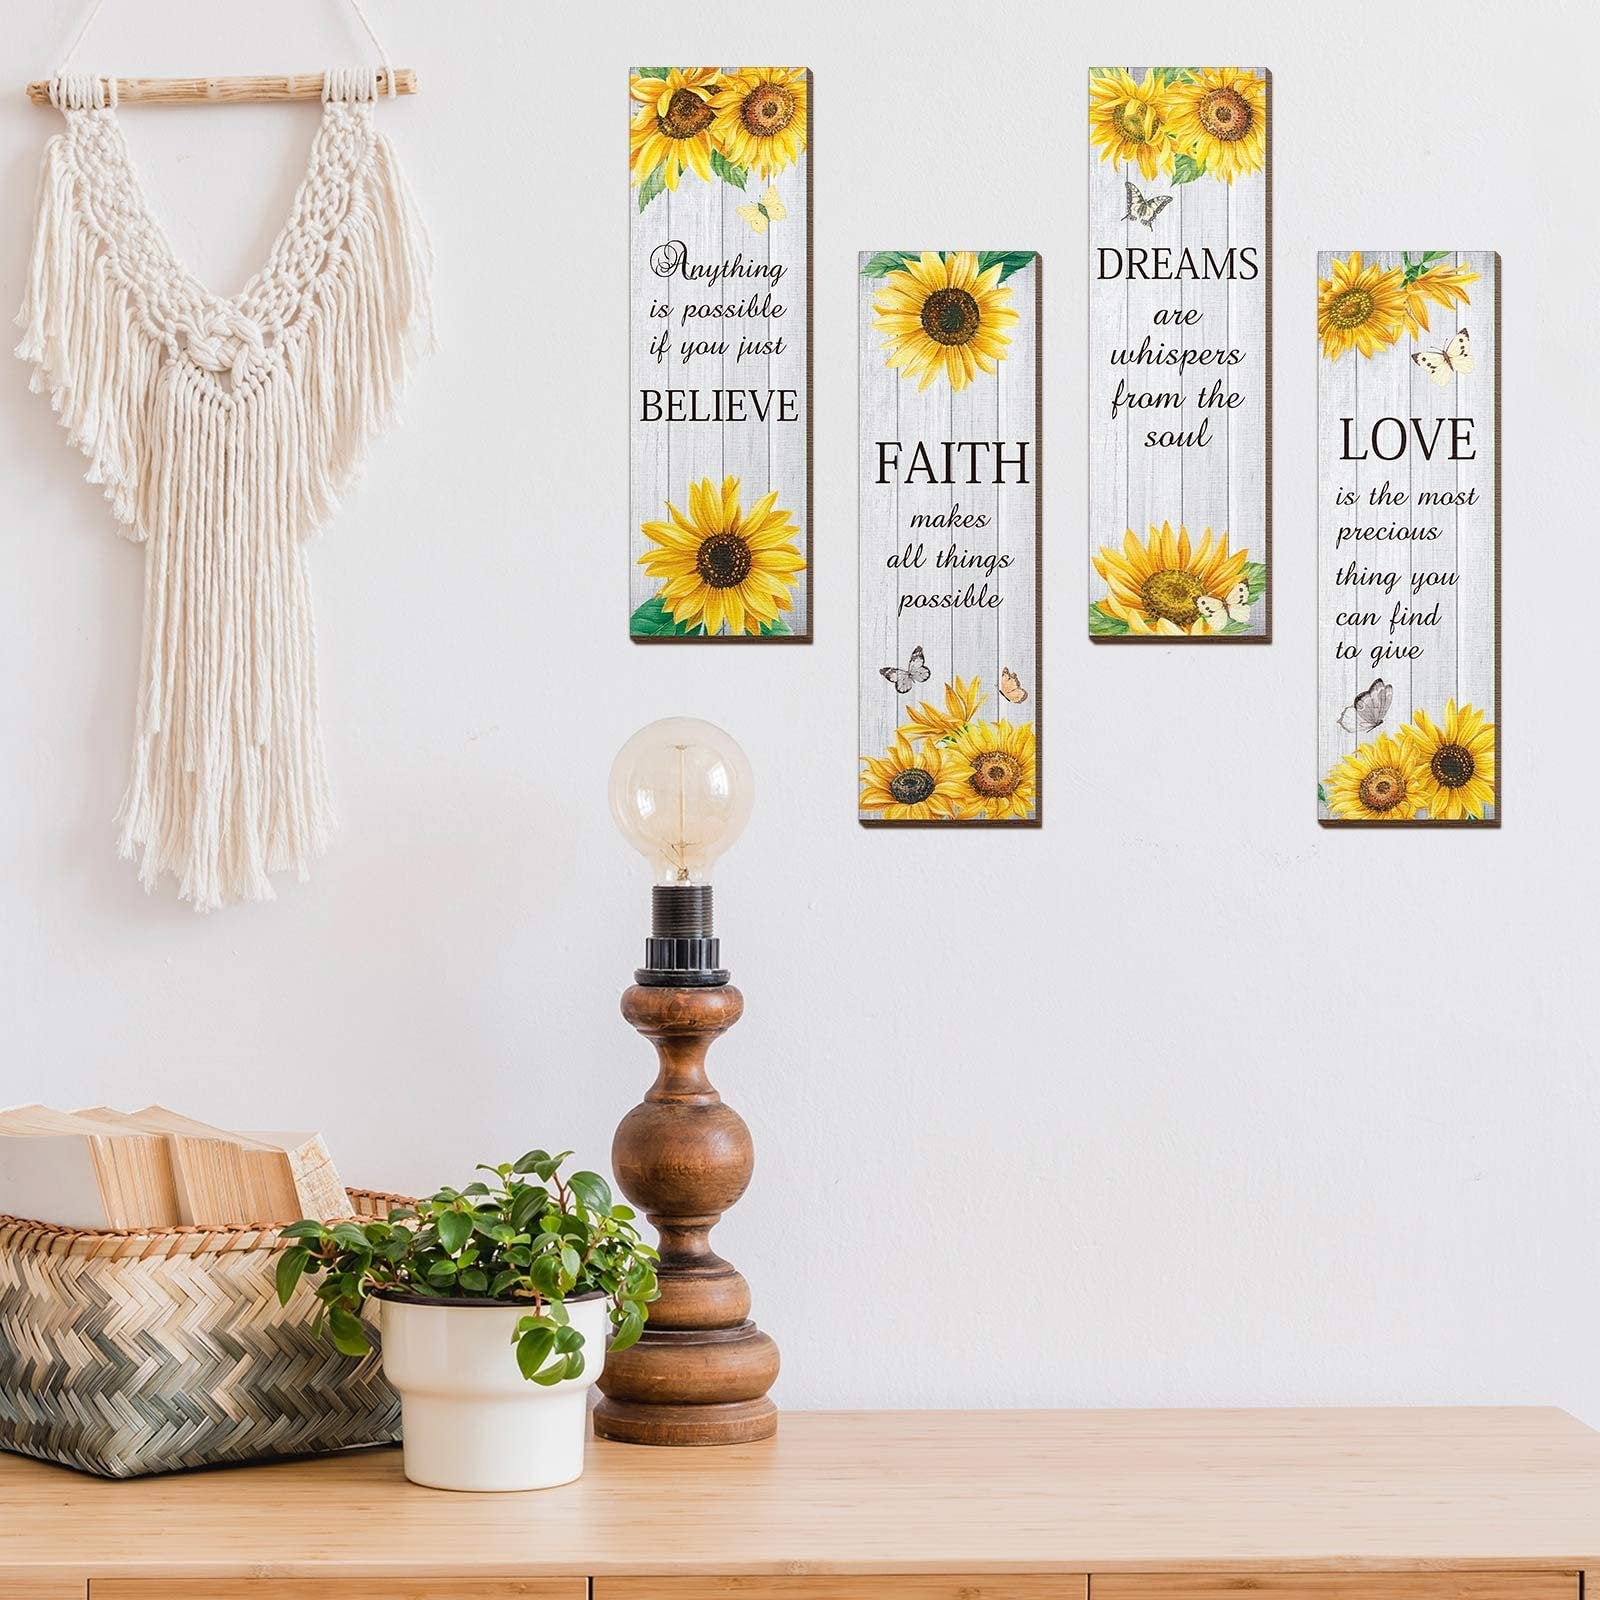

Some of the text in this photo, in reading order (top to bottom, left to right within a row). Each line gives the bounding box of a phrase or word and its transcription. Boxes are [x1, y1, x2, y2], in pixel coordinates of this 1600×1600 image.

[649, 239, 788, 288] Anything
[1097, 247, 1259, 280] DREAMS
[649, 292, 788, 328] is possible
[1153, 309, 1204, 325] are
[649, 330, 788, 364] if you just
[1110, 335, 1247, 376] whispers
[640, 389, 799, 422] BELIEVE
[1111, 378, 1246, 420] from the
[1144, 417, 1213, 447] soul
[1339, 417, 1477, 461] LOVE
[875, 441, 1030, 484] FAITH
[1335, 480, 1480, 506] is the most
[910, 503, 992, 529] makes
[1335, 521, 1443, 550] precious
[887, 543, 1015, 578] all things
[1335, 561, 1460, 595] thing you
[898, 583, 1004, 618] possible
[1335, 600, 1443, 635] can find
[1335, 640, 1424, 669] to give
